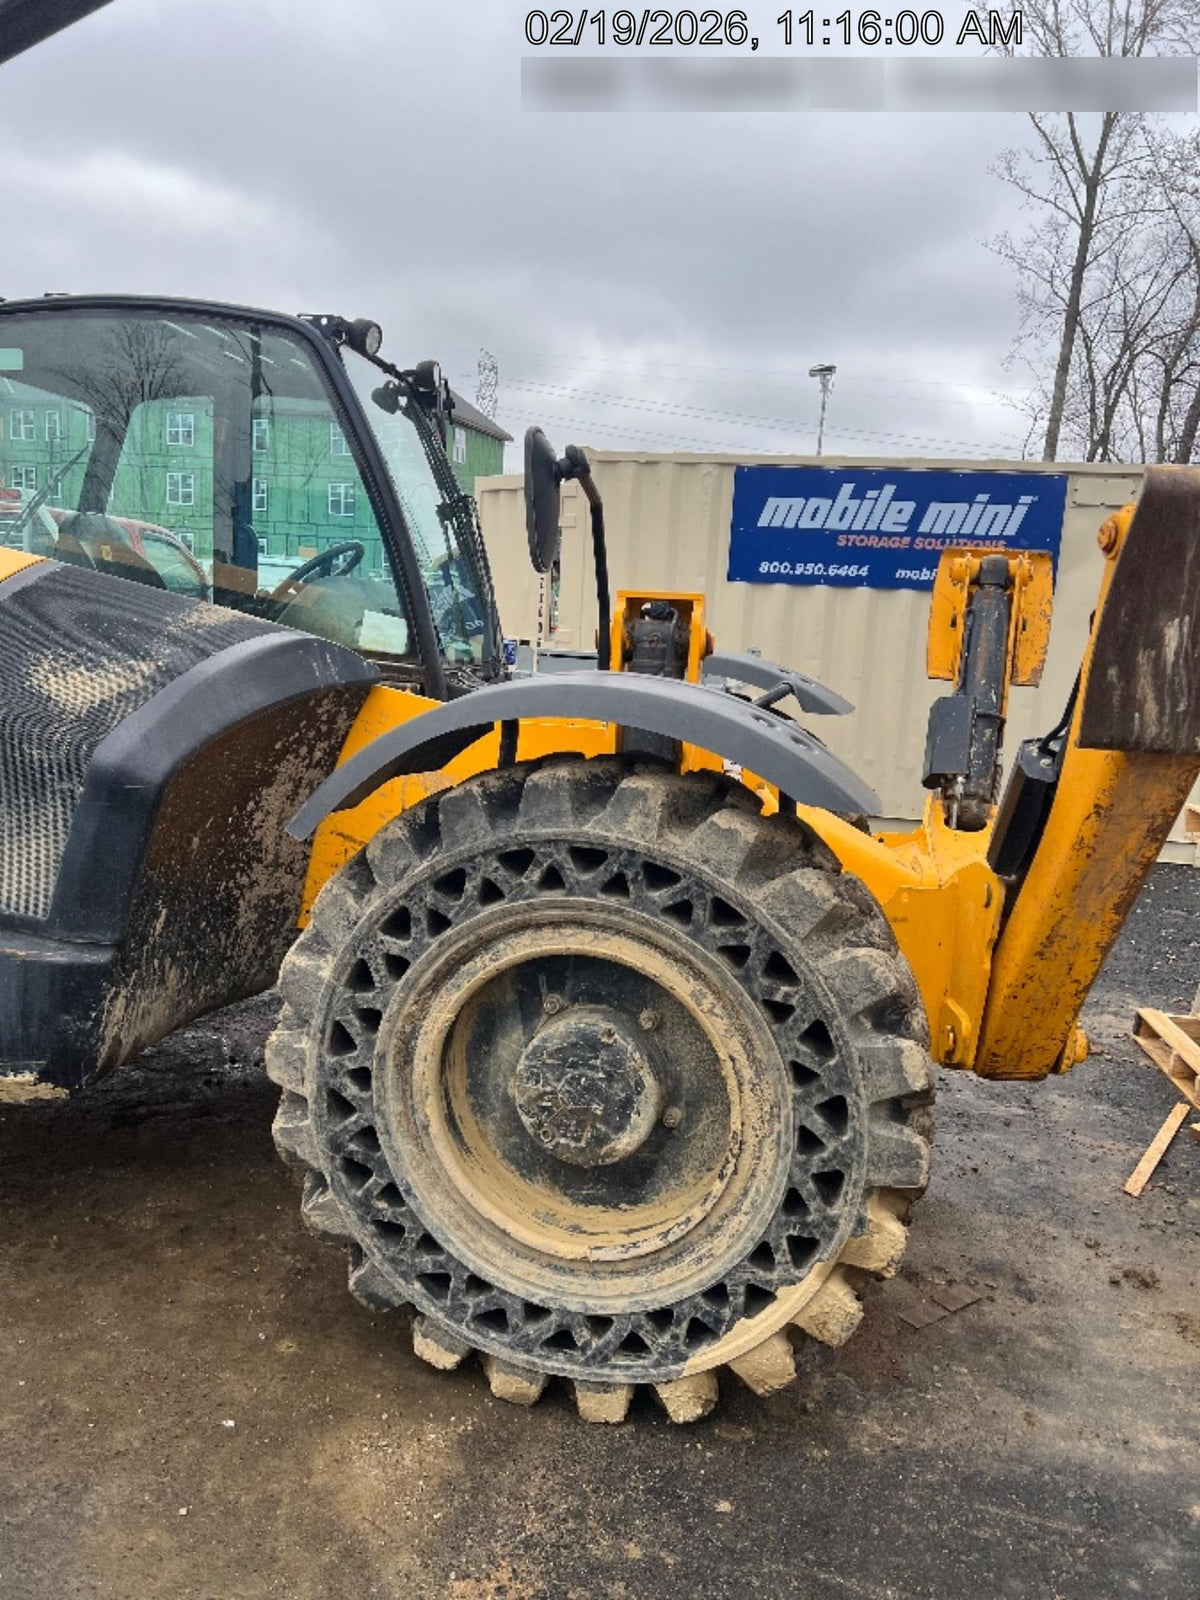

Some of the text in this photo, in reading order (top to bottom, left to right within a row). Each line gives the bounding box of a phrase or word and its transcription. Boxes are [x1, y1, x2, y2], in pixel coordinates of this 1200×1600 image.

[757, 483, 1034, 536] mobile mini
[837, 534, 1007, 551] STORAGE SOLUTIONS
[759, 561, 870, 577] 800.950.6464
